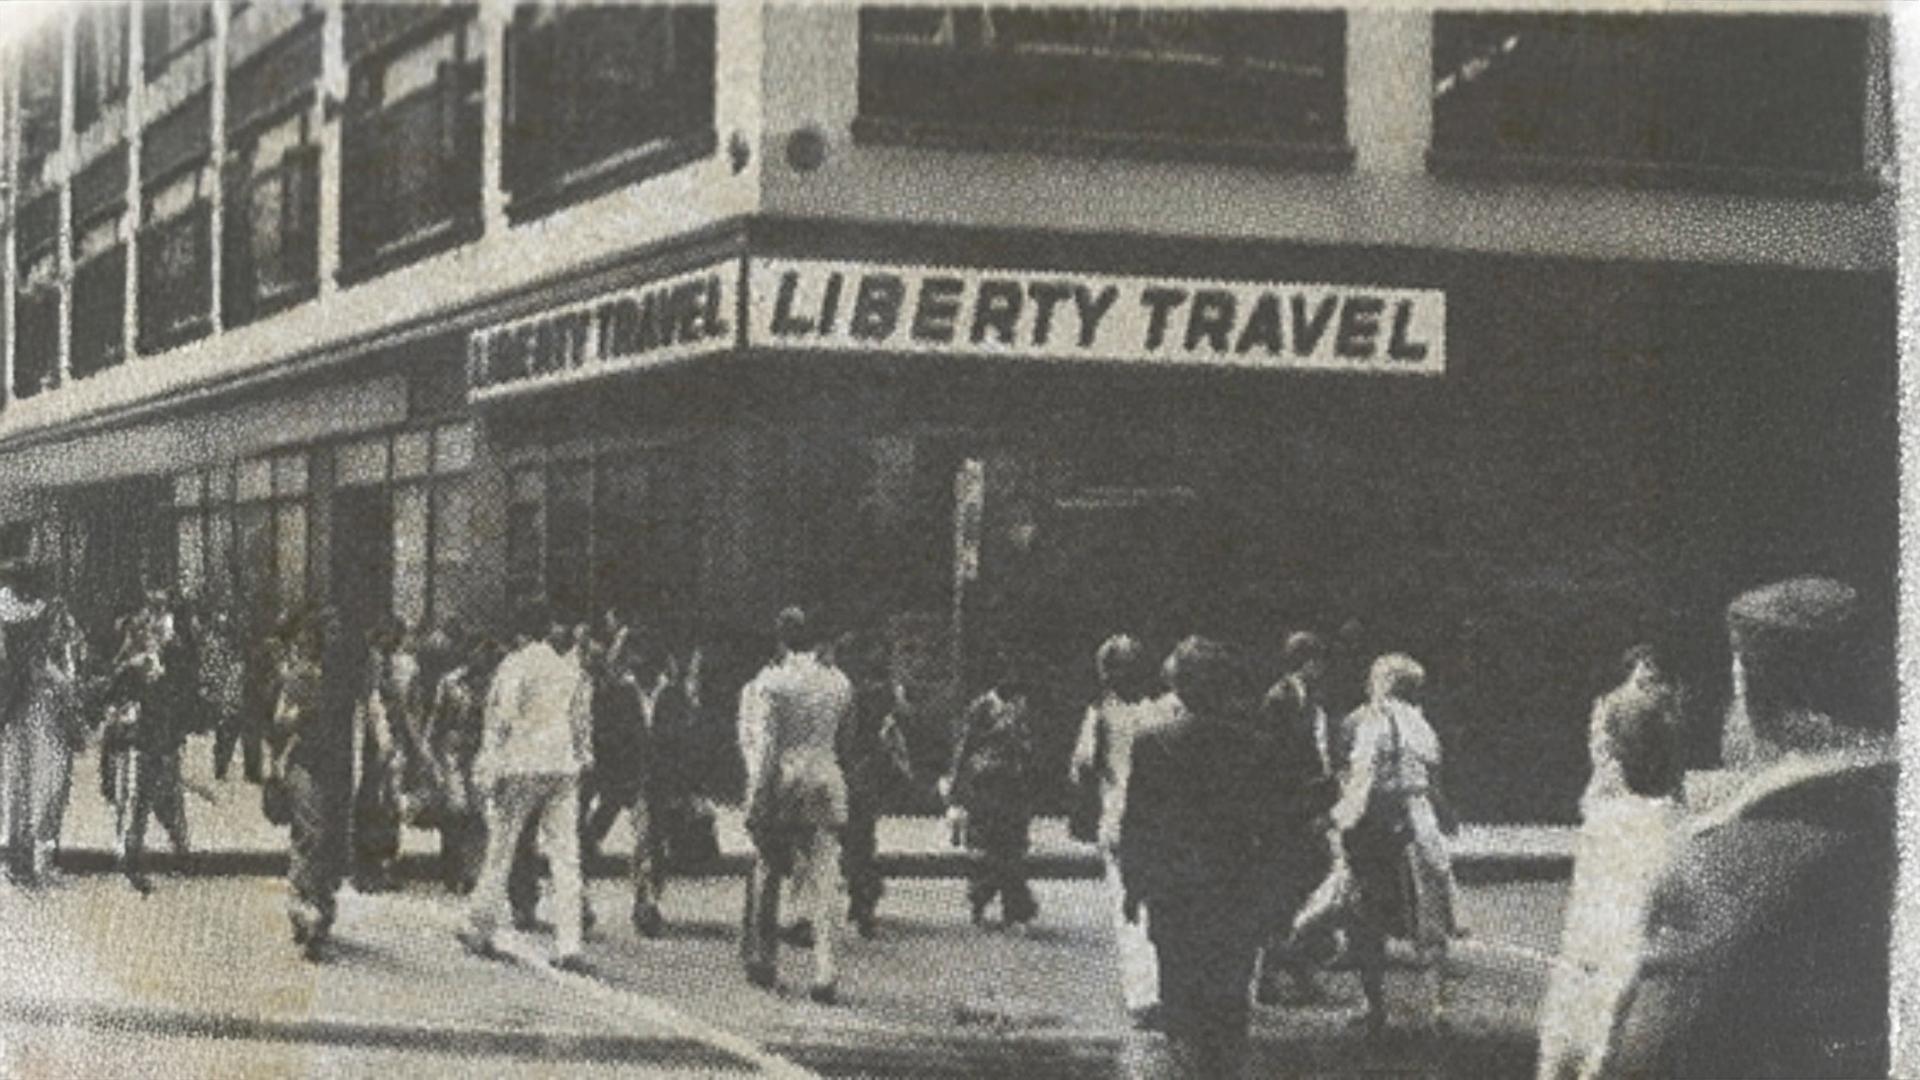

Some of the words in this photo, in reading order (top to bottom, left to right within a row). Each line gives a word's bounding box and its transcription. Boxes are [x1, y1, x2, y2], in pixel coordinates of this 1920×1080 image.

[600, 274, 728, 360] TRAVEL
[770, 271, 1118, 348] LIBERTY
[1141, 288, 1428, 361] TRAVEL
